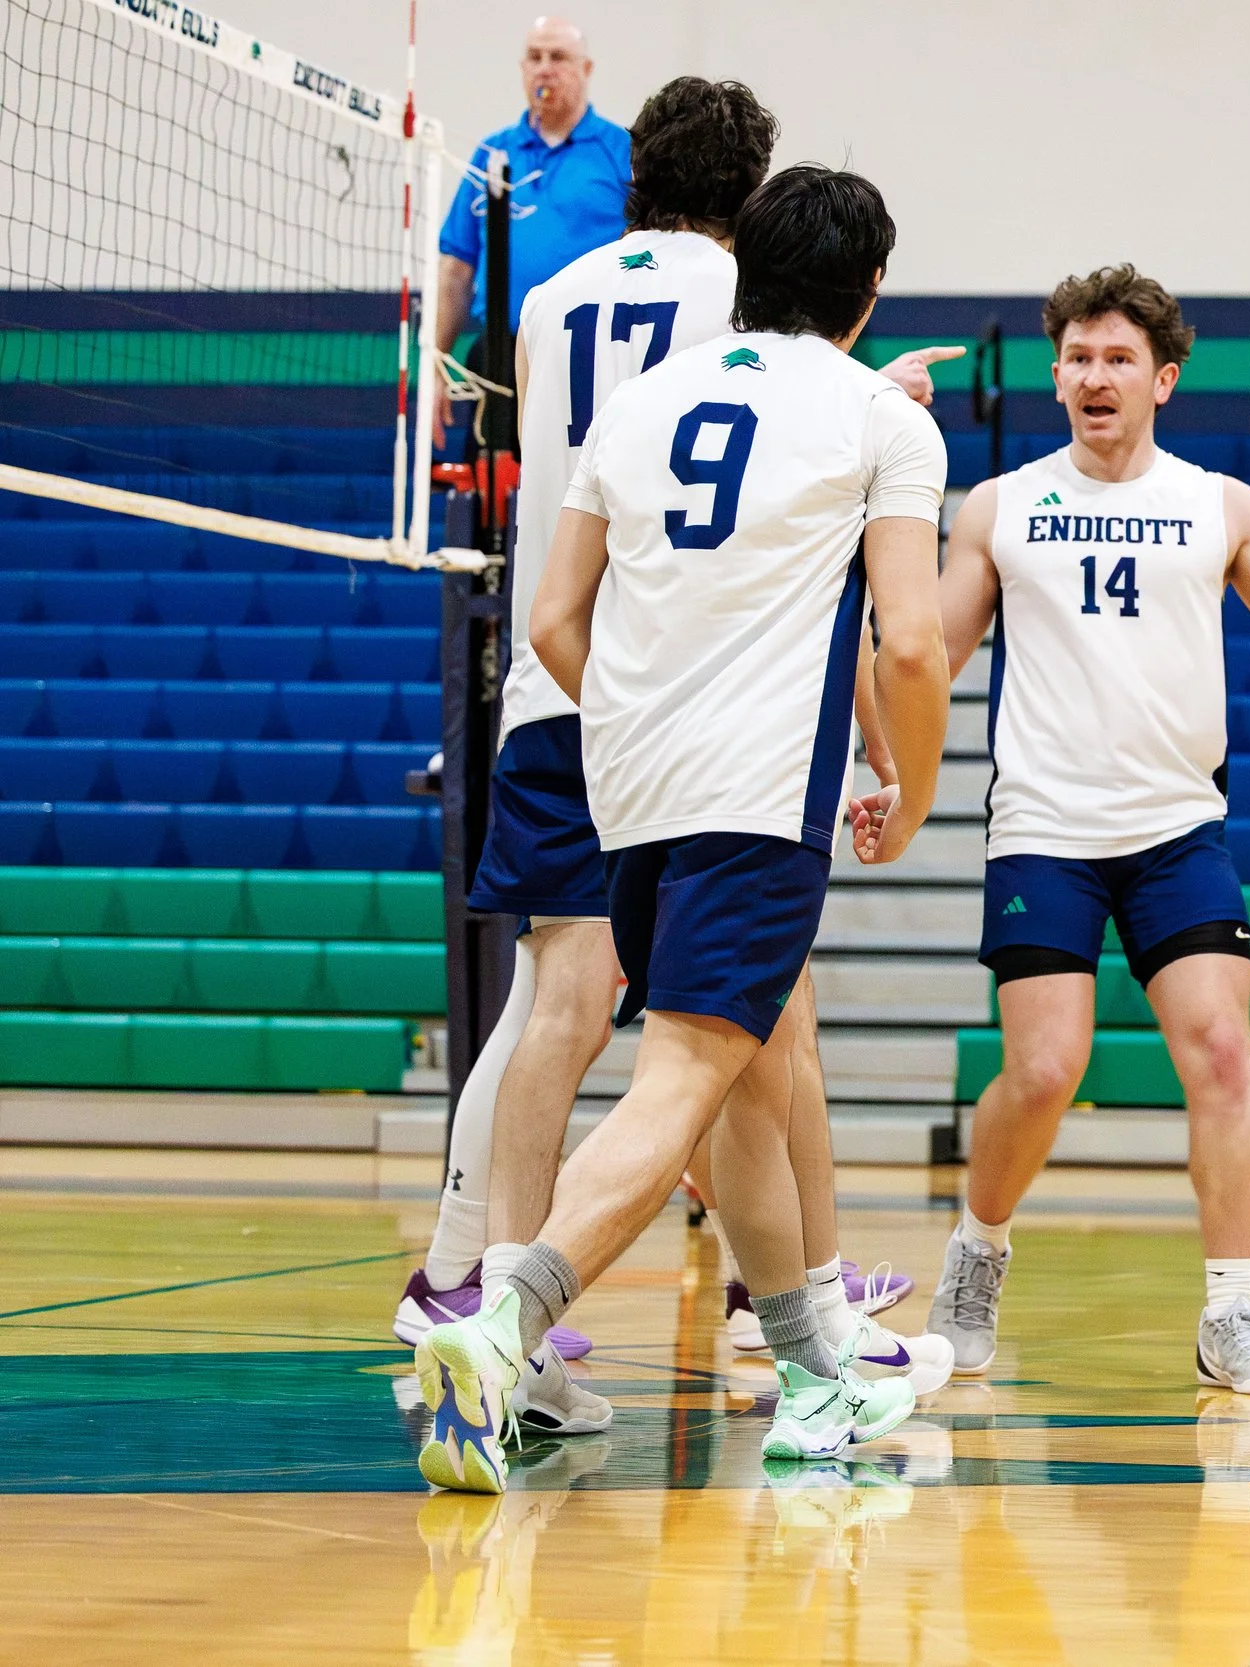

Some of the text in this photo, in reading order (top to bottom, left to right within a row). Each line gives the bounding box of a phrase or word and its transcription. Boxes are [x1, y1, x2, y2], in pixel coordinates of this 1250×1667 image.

[563, 301, 680, 447] 17
[664, 401, 759, 550] 9
[1027, 515, 1193, 546] ENDICOTT
[1080, 555, 1140, 617] 14
